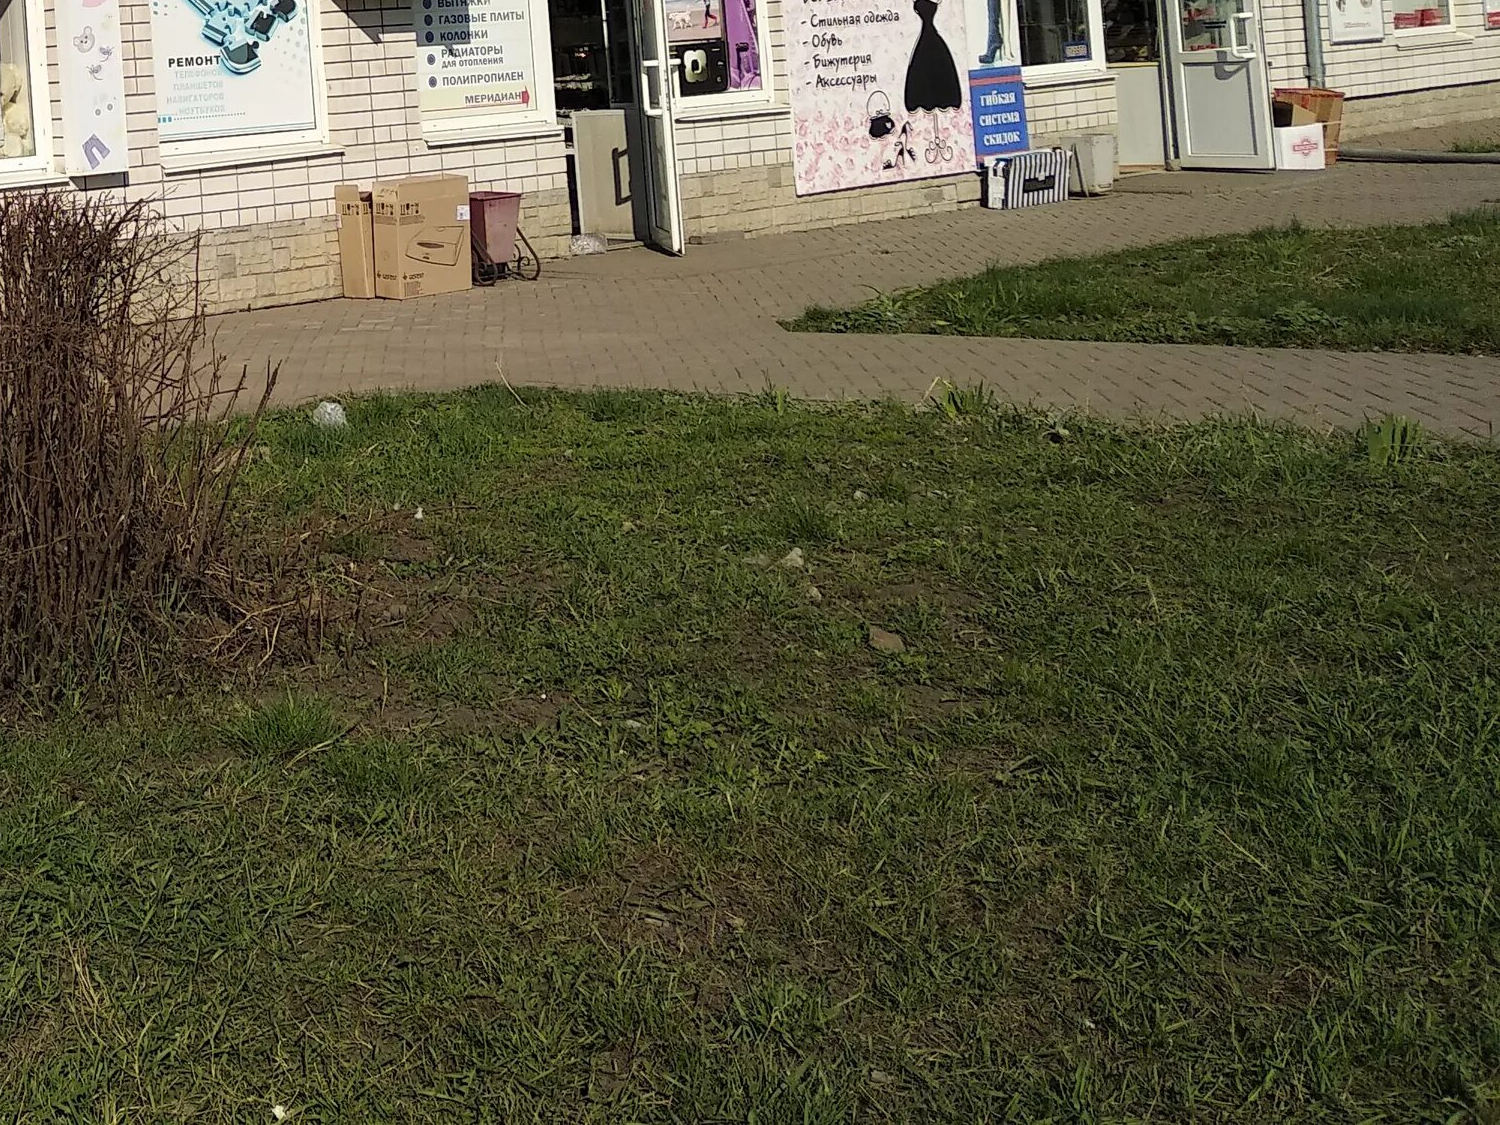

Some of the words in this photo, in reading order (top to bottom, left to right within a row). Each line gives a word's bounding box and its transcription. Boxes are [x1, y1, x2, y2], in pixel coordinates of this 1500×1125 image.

[439, 13, 487, 25] ГАЗОВЫЕ
[490, 11, 524, 22] ПЛИТЫ
[810, 14, 860, 28] Стильная
[864, 9, 900, 24] одежда
[440, 29, 488, 41] КОЛОНКИ
[812, 32, 842, 53] Обувь
[441, 45, 503, 58] РАДИАТОРЫ
[168, 55, 221, 68] РЕМОНТ
[441, 60, 456, 69] для
[458, 57, 504, 67] отопления
[812, 53, 872, 73] Бижутерия
[442, 71, 524, 86] ПОЛИПРОПИЛЕН
[815, 74, 877, 91] Аксессуары
[465, 92, 521, 104] МЕРИДИАН
[980, 90, 1016, 107] гибкая
[979, 111, 1020, 126] система
[983, 131, 1021, 146] скидок
